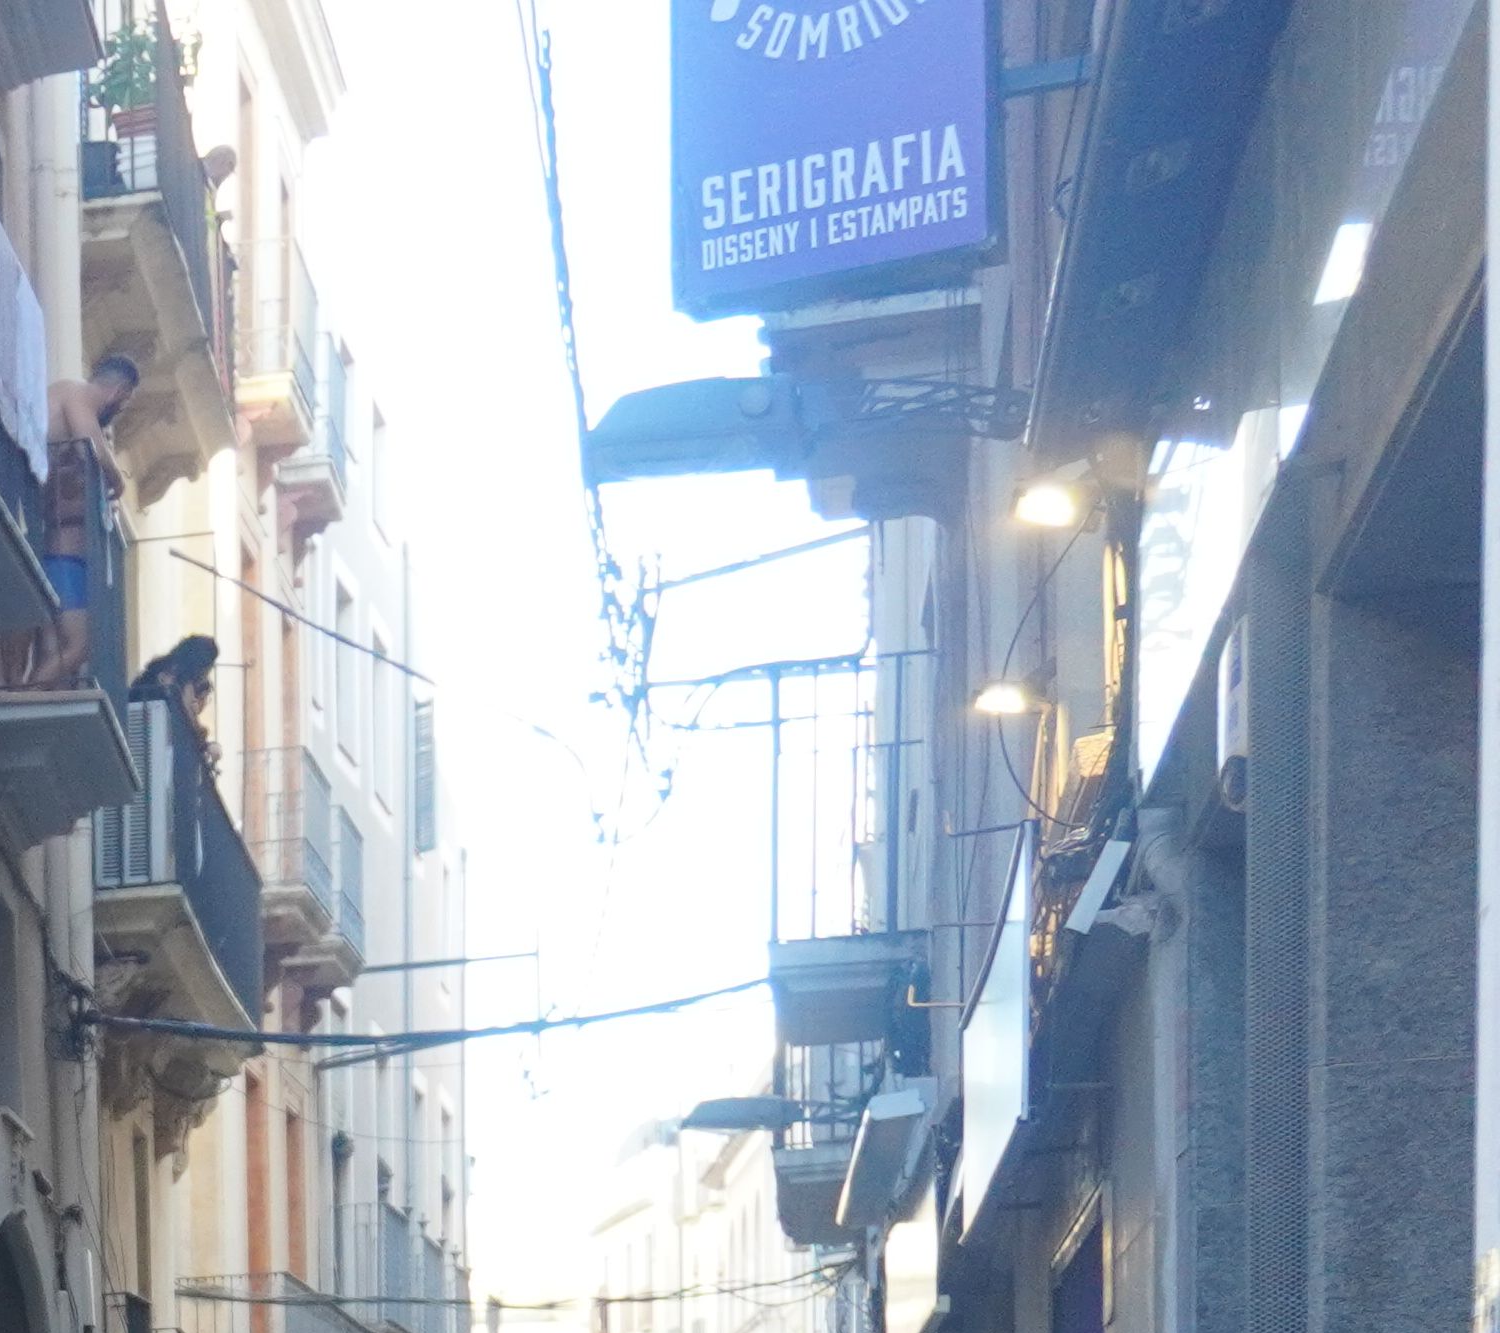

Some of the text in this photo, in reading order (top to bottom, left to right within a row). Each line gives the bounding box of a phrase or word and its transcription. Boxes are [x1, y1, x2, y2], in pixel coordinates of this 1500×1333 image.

[702, 124, 966, 230] SERIGRAFIA
[702, 186, 968, 271] DISSENY I ESTAMPATS
